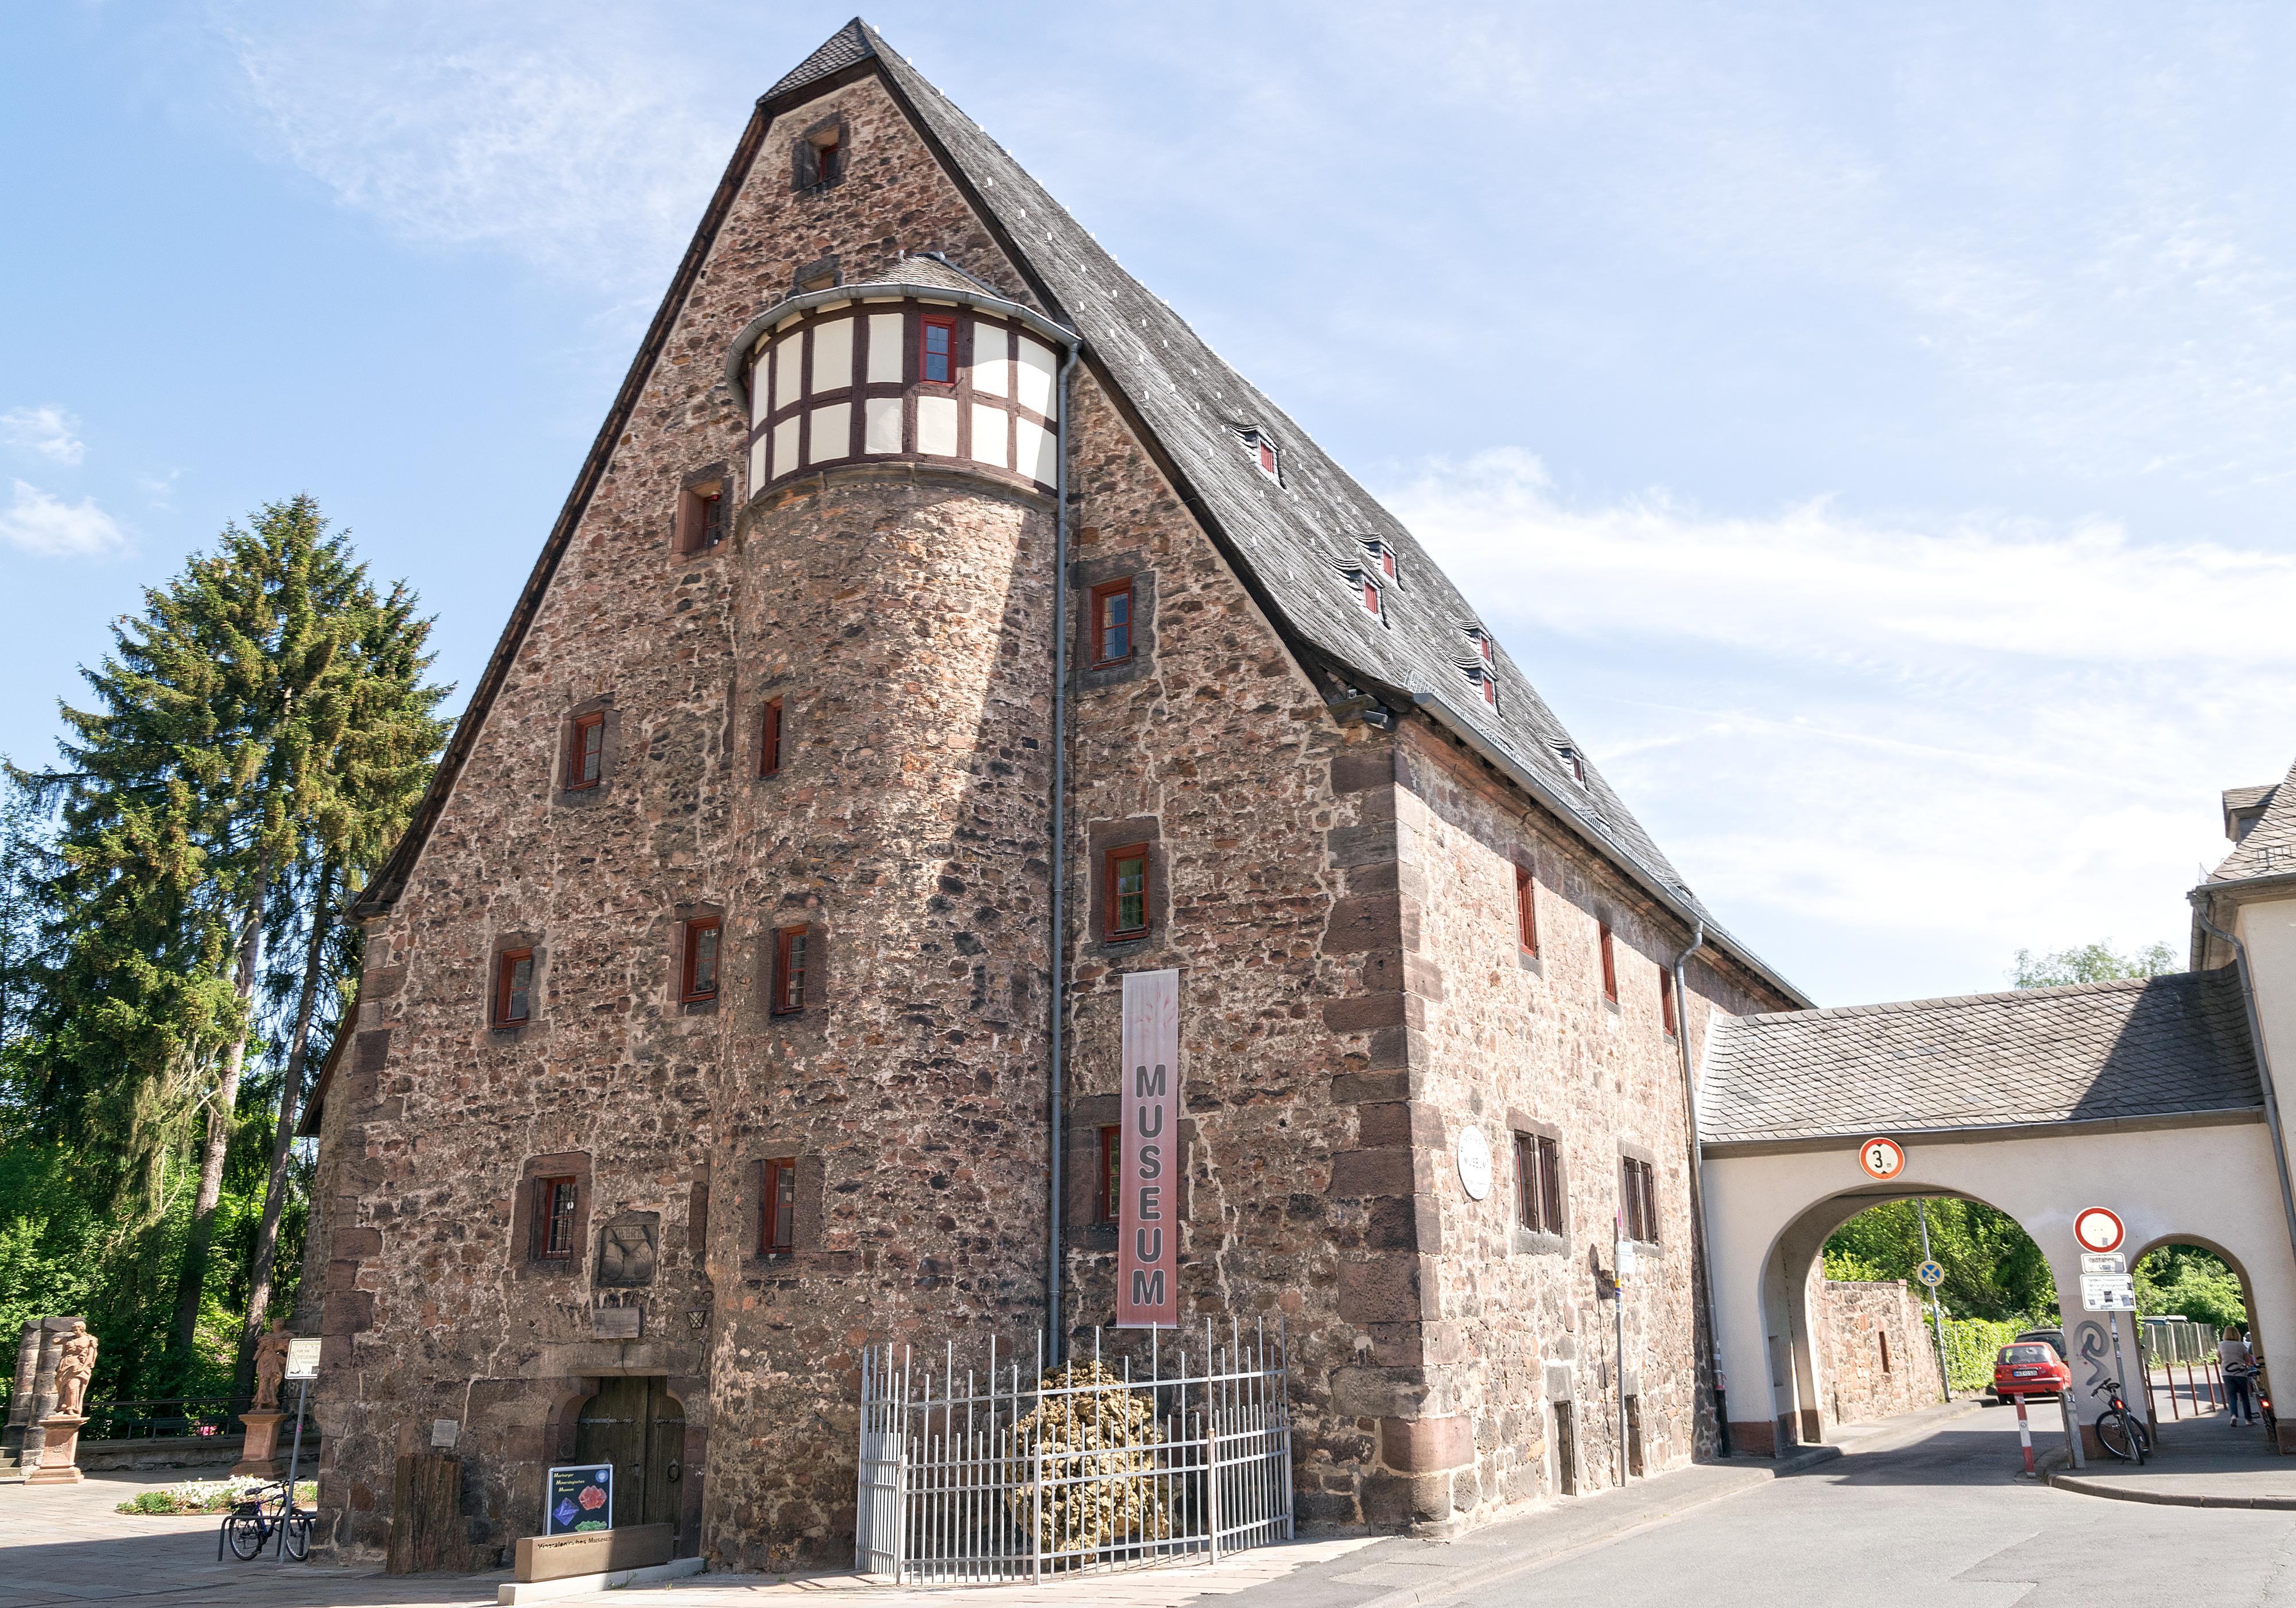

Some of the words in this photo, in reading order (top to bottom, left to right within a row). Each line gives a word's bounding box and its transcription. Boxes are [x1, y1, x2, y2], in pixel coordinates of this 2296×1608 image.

[1872, 1150, 1883, 1168] 3
[1131, 1064, 1166, 1306] MUSEUM
[537, 1539, 586, 1550] Mineralogisches
